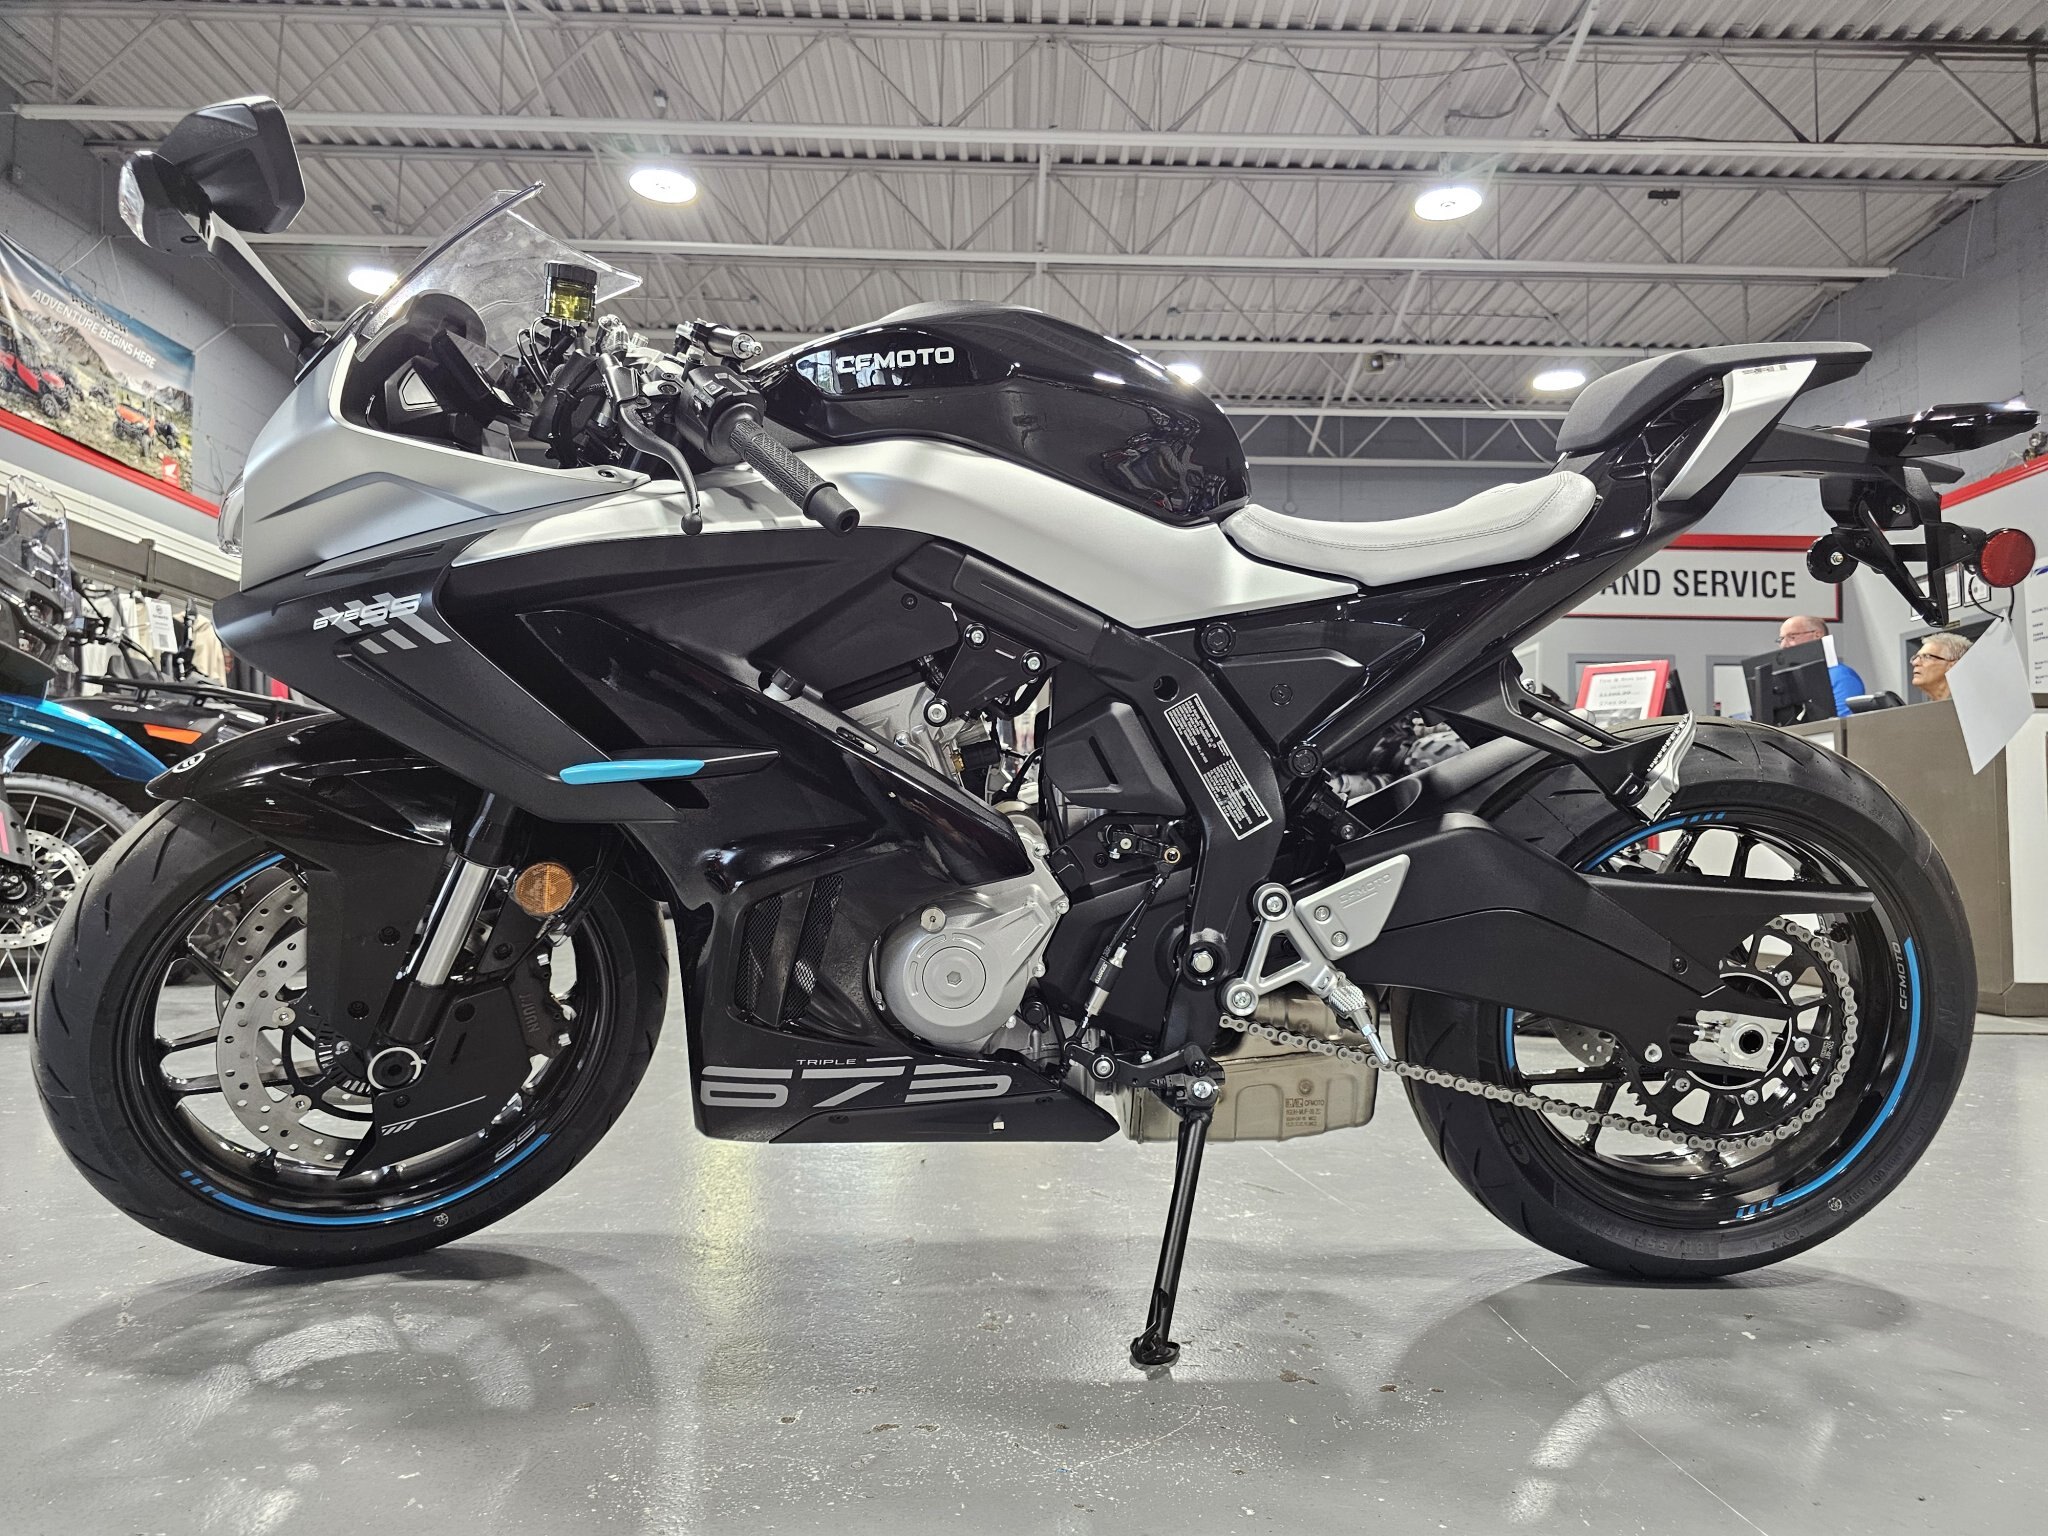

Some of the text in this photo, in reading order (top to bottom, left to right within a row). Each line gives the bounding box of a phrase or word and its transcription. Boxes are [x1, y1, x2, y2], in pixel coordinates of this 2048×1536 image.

[31, 289, 157, 369] ADVENTURE BEGINS HERE
[836, 347, 954, 374] CFMOTO
[1601, 569, 1796, 599] AND SERVICE
[1891, 941, 1908, 1010] CFMOTO
[797, 1058, 857, 1066] TRIPLE
[701, 1063, 1012, 1108] 675
